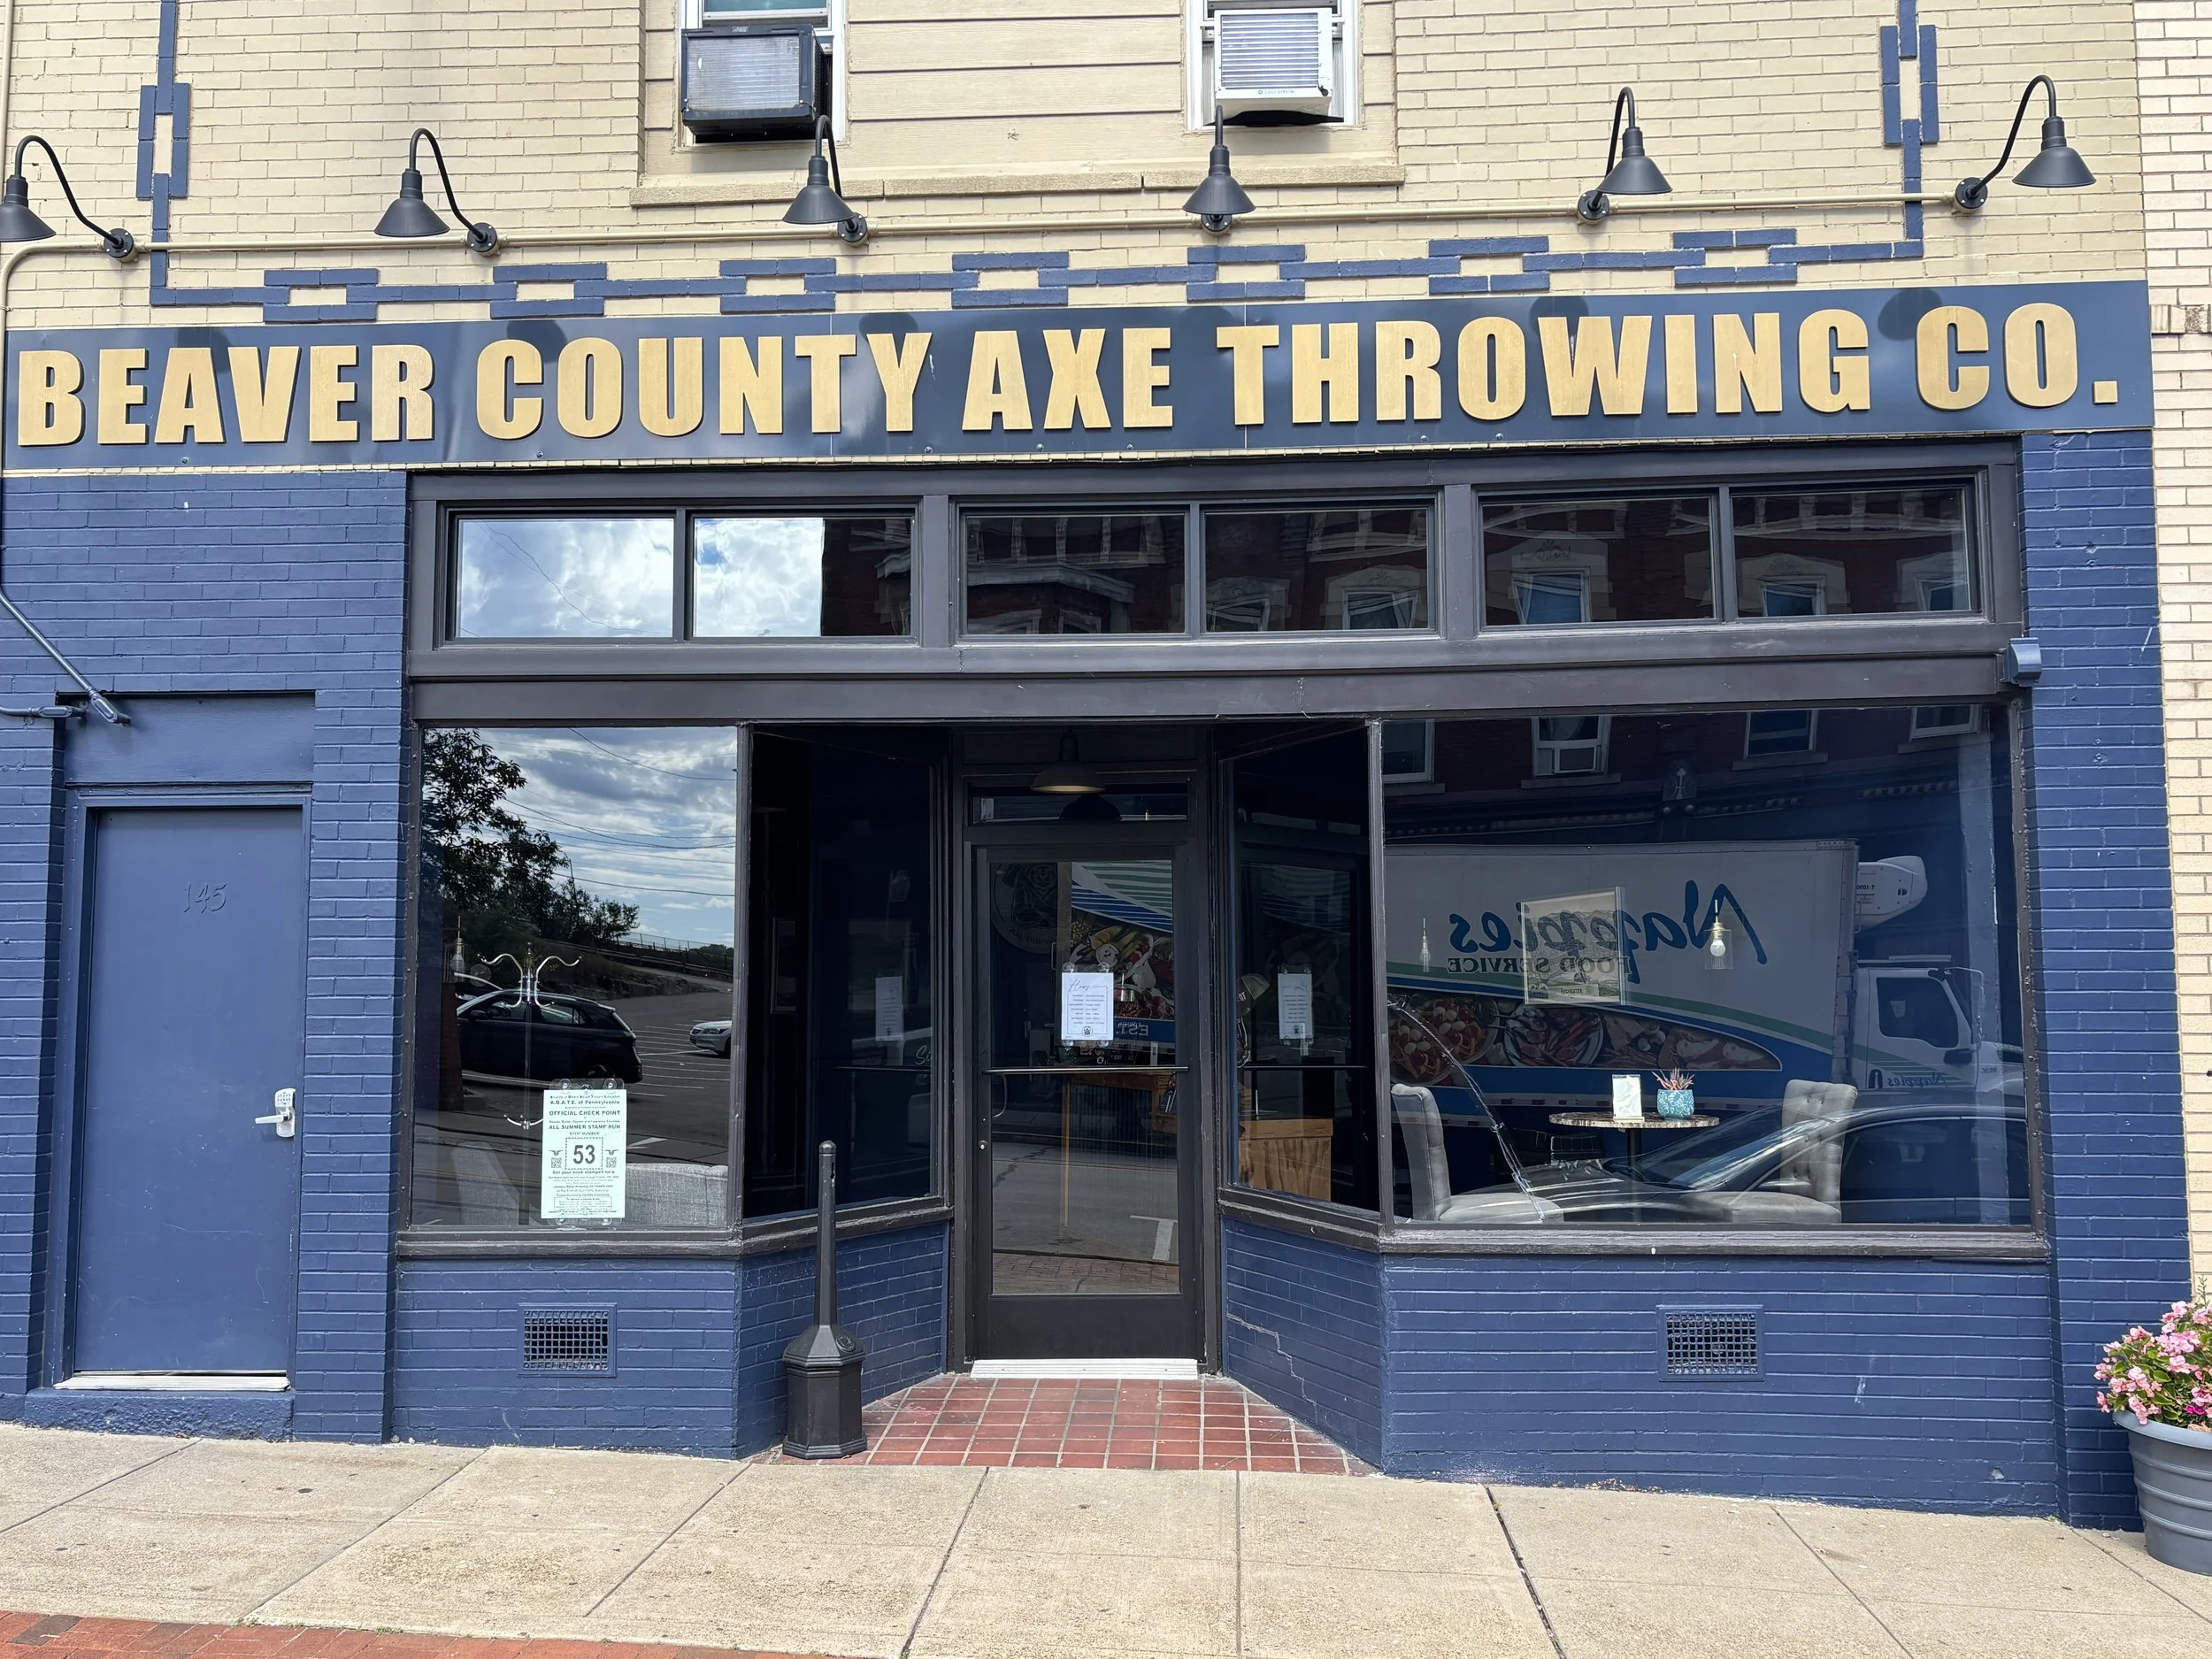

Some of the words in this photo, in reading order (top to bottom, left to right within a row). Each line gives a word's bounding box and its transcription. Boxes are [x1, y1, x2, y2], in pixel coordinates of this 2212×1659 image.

[18, 344, 434, 447] BEAVER
[476, 333, 932, 441] COUNTY
[962, 327, 1174, 432] AXE
[1216, 308, 1870, 426] THROWING
[1915, 303, 2119, 411] CO.
[183, 883, 227, 913] 145
[572, 1144, 595, 1164] 53
